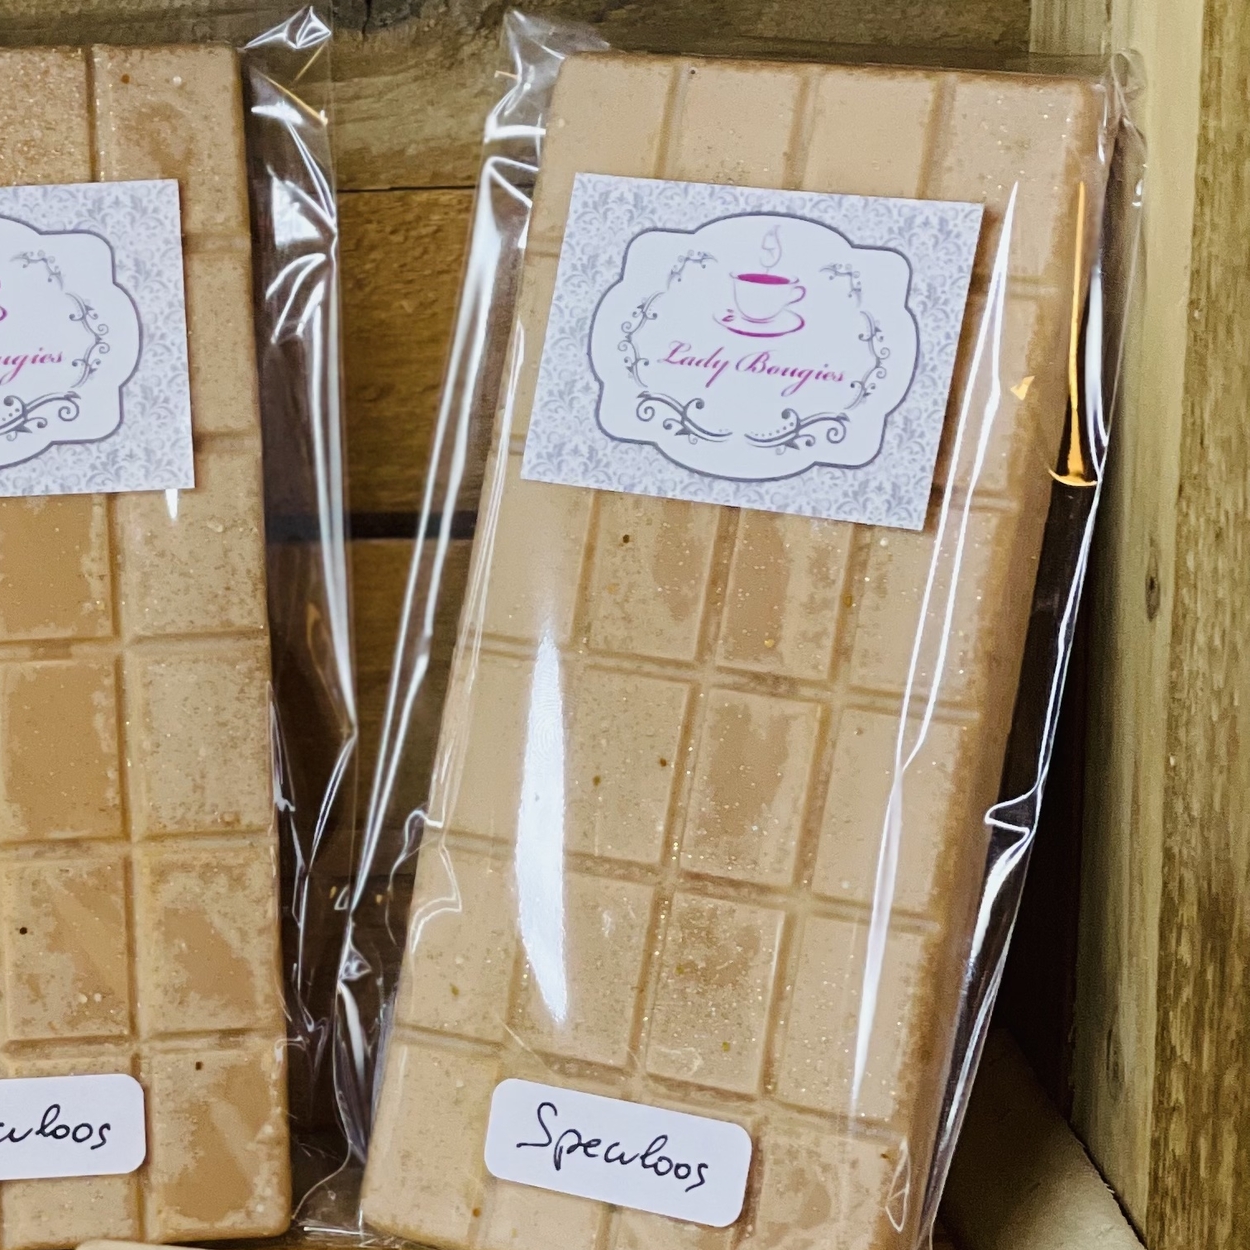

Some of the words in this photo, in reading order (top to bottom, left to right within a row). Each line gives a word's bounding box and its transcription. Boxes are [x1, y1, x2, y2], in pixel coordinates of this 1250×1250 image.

[657, 340, 729, 388] Lady
[735, 350, 844, 397] Bougies
[516, 1101, 709, 1193] Speculoos
